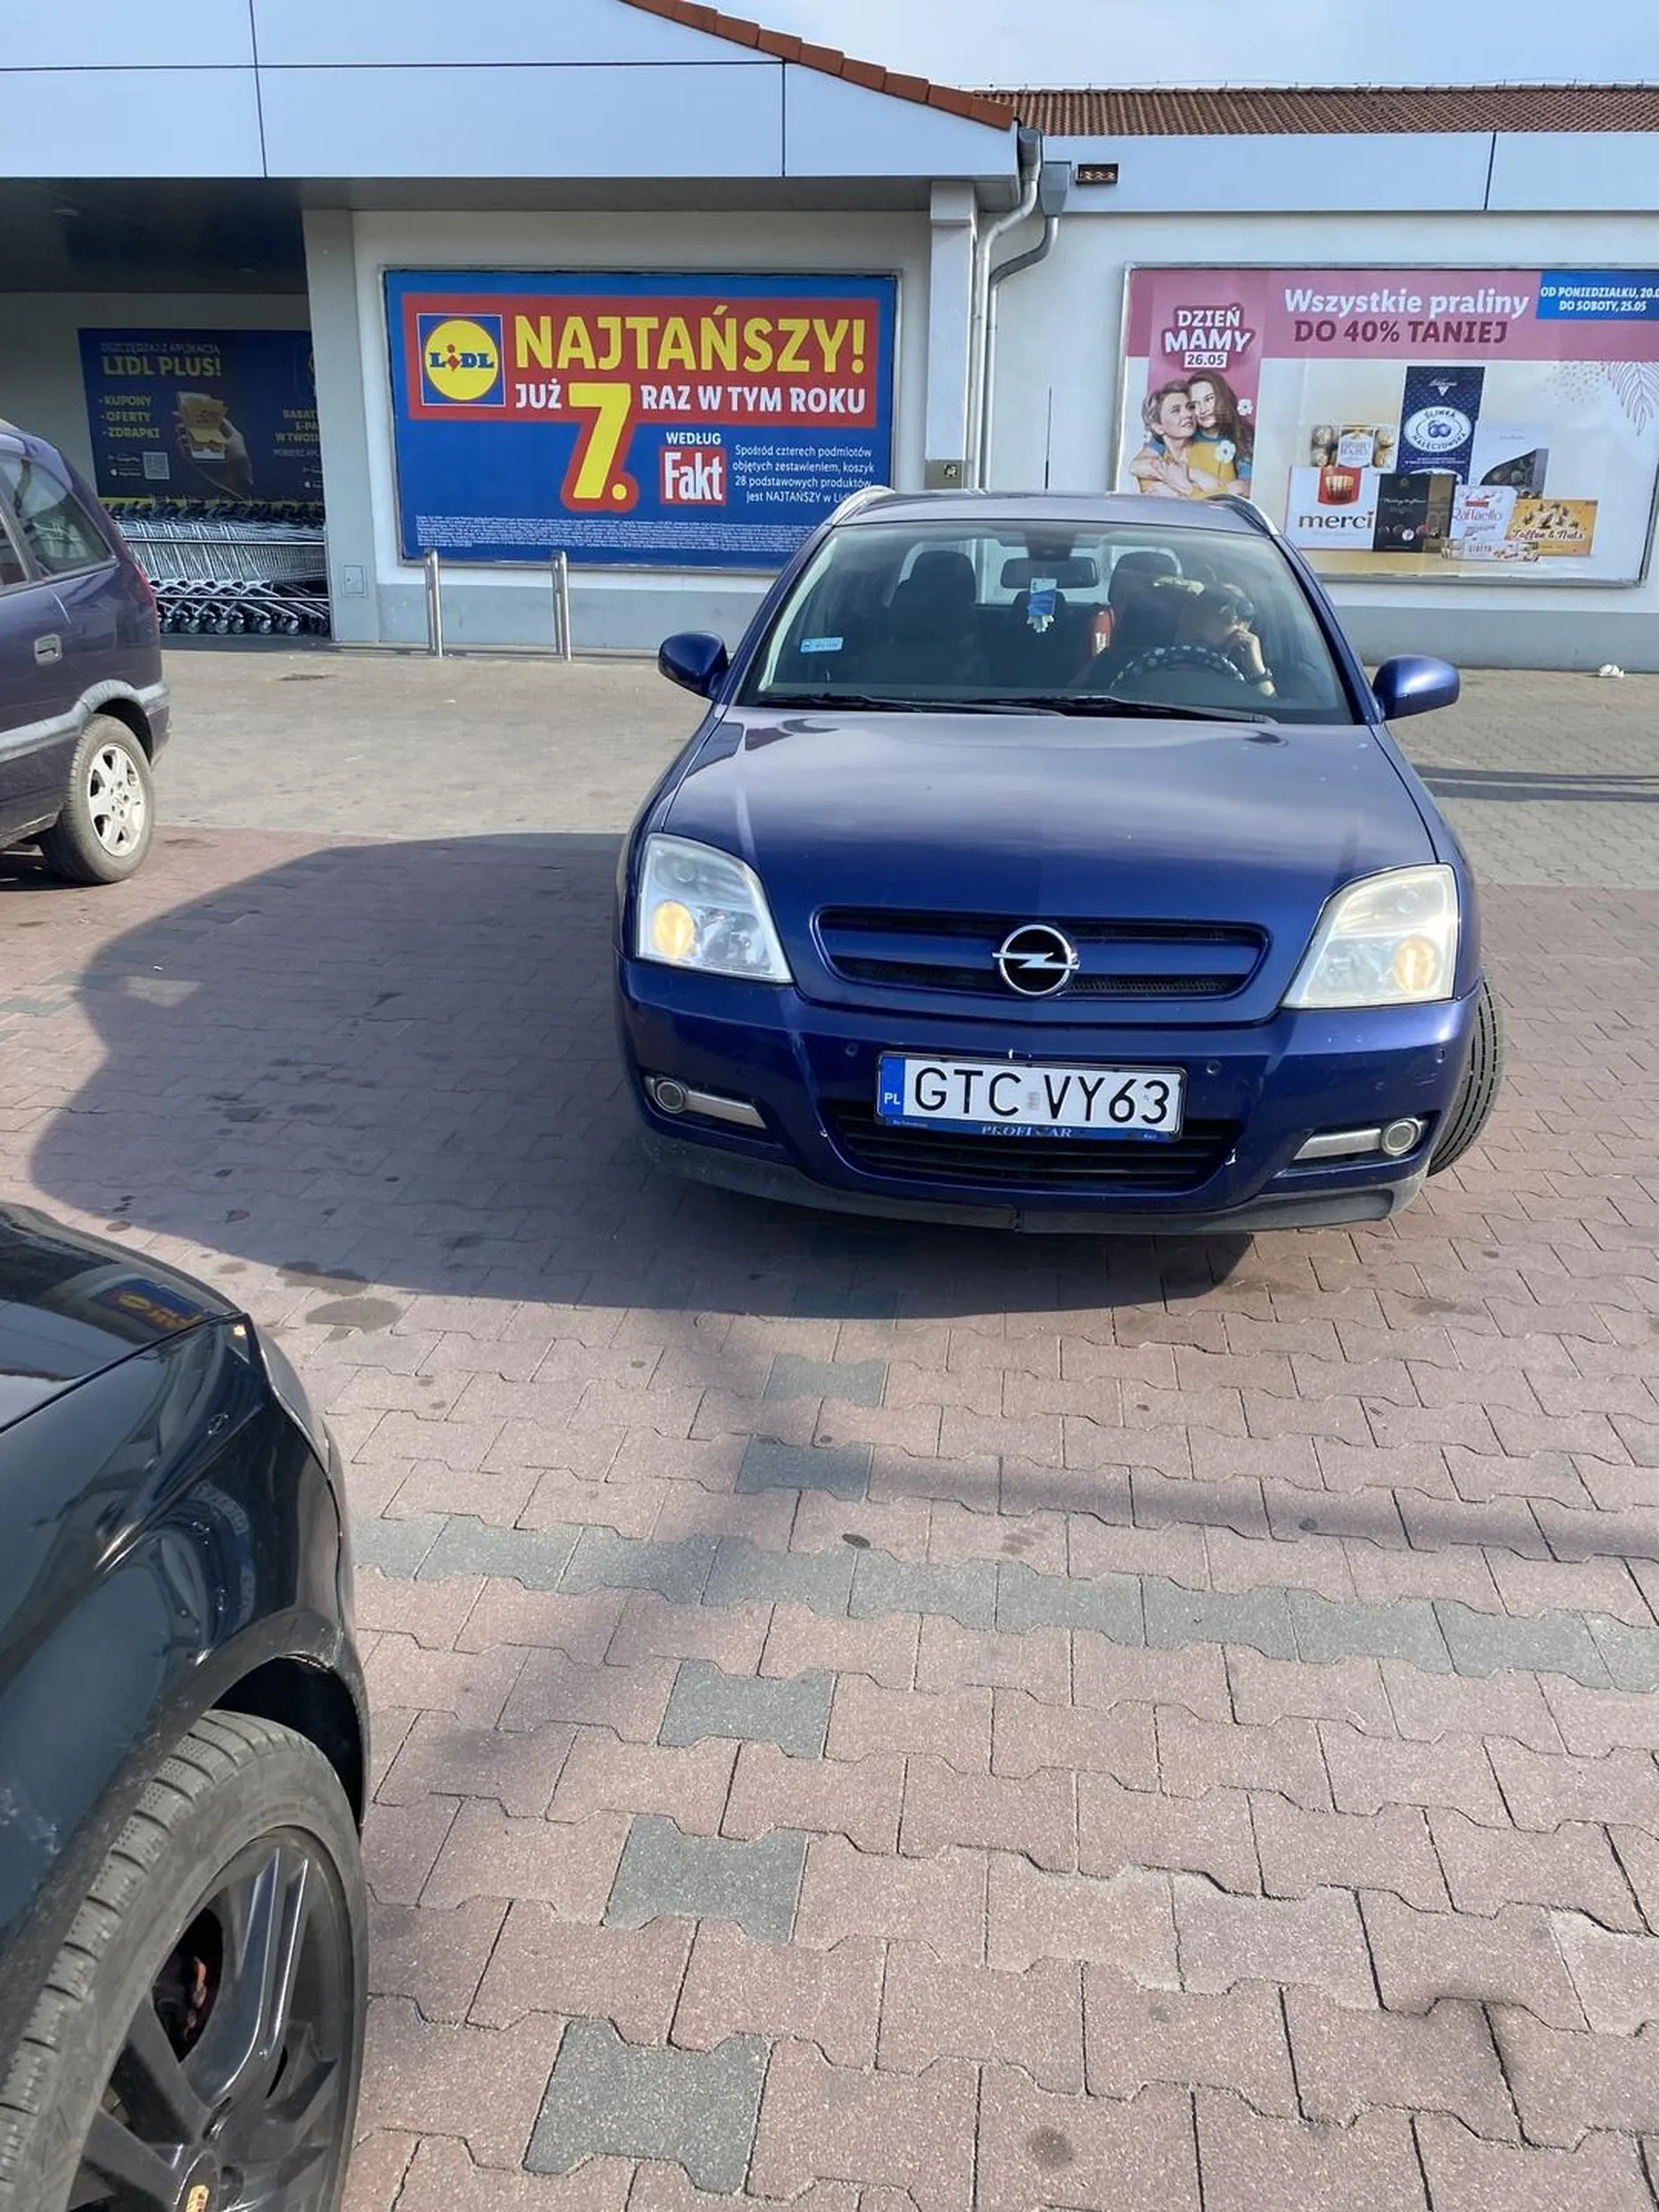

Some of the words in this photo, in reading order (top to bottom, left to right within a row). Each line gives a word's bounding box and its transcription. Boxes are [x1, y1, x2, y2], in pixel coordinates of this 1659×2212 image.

[1540, 286, 1557, 297] OD
[1284, 288, 1423, 319] Wszystkie
[1428, 288, 1530, 319] praliny
[1559, 300, 1576, 311] DO
[1576, 300, 1619, 312] SOBOTY,
[1620, 301, 1647, 311] 25.05
[1177, 306, 1240, 327] DZIEŃ
[514, 304, 865, 374] NAJTAŃSZY!
[1164, 328, 1252, 353] MAMY
[1294, 319, 1337, 342] DO
[1343, 319, 1400, 342] 40%
[1408, 320, 1509, 343] TANIEJ
[103, 356, 155, 375] LIDL
[157, 356, 222, 376] PLUS!
[1187, 354, 1225, 365] 26.05
[515, 377, 563, 410] JUŻ
[568, 382, 632, 501] 7.
[641, 385, 691, 411] RAZ
[697, 385, 723, 411] W
[727, 386, 782, 412] TYM
[789, 387, 866, 414] ROKU
[665, 432, 722, 445] WEDŁUG
[735, 444, 773, 457] Spośród
[775, 445, 816, 457] czterech
[818, 445, 872, 458] podmiotów
[664, 451, 723, 501] Fakt
[733, 460, 773, 472] objętych
[775, 462, 841, 473] zestawieniem,
[842, 463, 874, 475] koszyk
[734, 475, 746, 487] 28
[749, 476, 818, 489] podstawowych
[820, 478, 872, 488] produktów
[745, 491, 763, 504] jest
[765, 490, 821, 503] NAJTAŃSZY
[1298, 511, 1375, 530] merci
[884, 1092, 902, 1105] PL
[913, 1066, 1022, 1117] GTC
[1043, 1073, 1171, 1125] VY63
